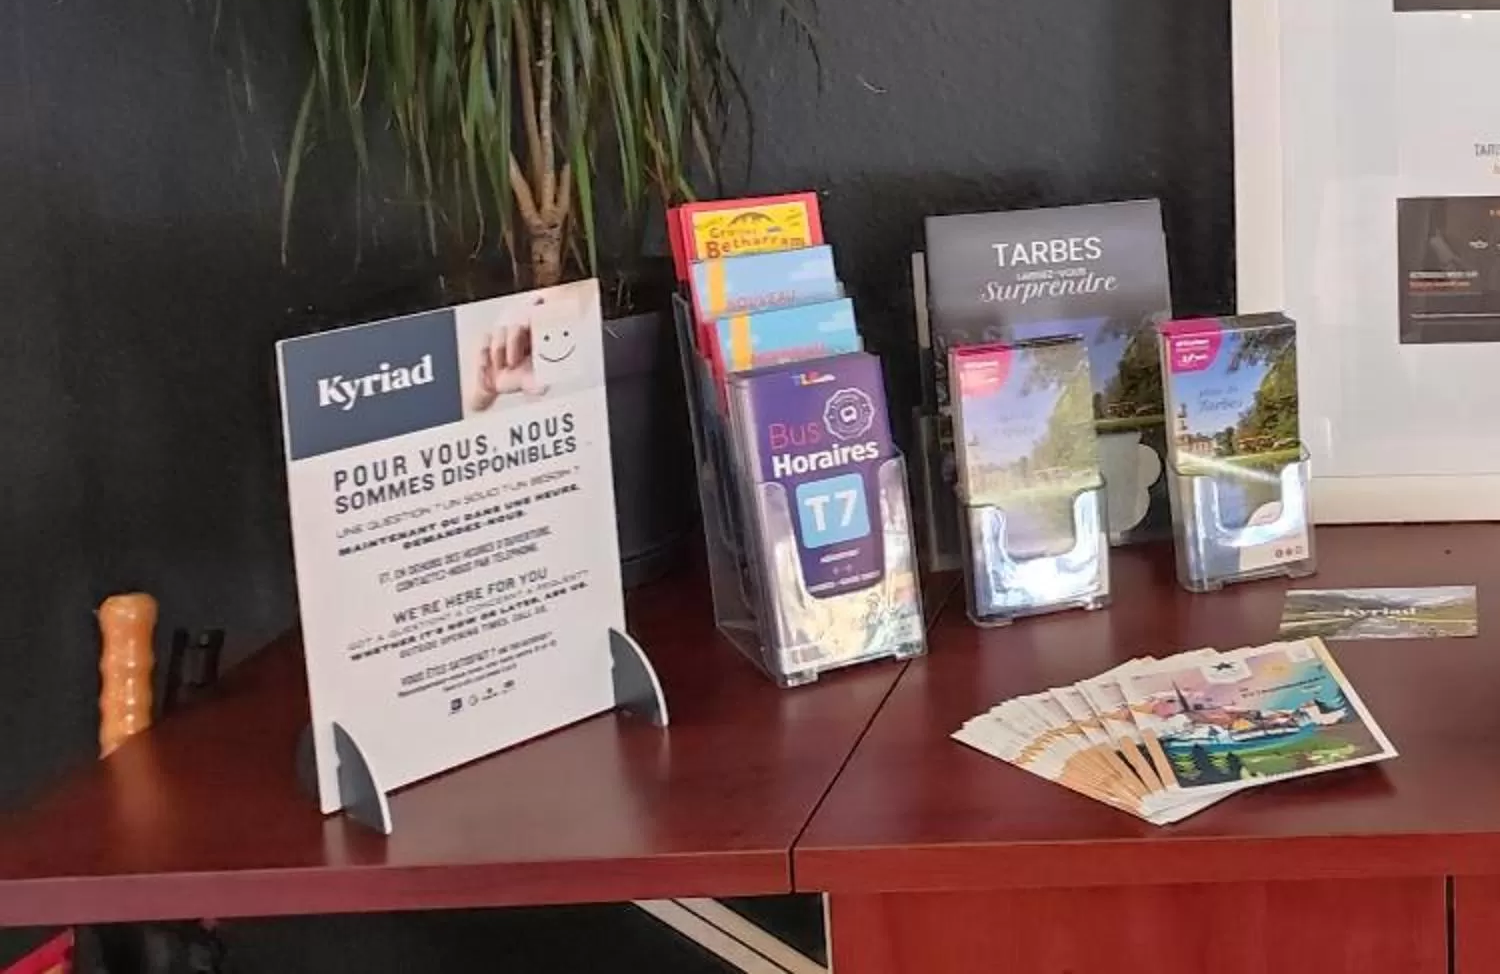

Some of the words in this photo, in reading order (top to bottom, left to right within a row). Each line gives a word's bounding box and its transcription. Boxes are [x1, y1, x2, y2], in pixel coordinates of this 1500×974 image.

[992, 237, 1103, 268] TARBES
[980, 271, 1119, 306] Surprendre
[318, 354, 435, 411] Kyriad
[334, 454, 409, 493] POUR
[509, 412, 575, 448] NOUS
[768, 421, 821, 451] Bus
[335, 472, 436, 515] SOMMES
[442, 435, 577, 487] DISPONIBLES
[771, 440, 880, 479] Horaires
[803, 489, 859, 533] T7
[338, 522, 438, 558] MAINTENANT
[392, 600, 441, 625] WE'RE
[445, 587, 484, 609] HERE
[487, 576, 517, 596] FOR
[519, 566, 550, 586] YOU
[1343, 605, 1418, 620] Kyriad
